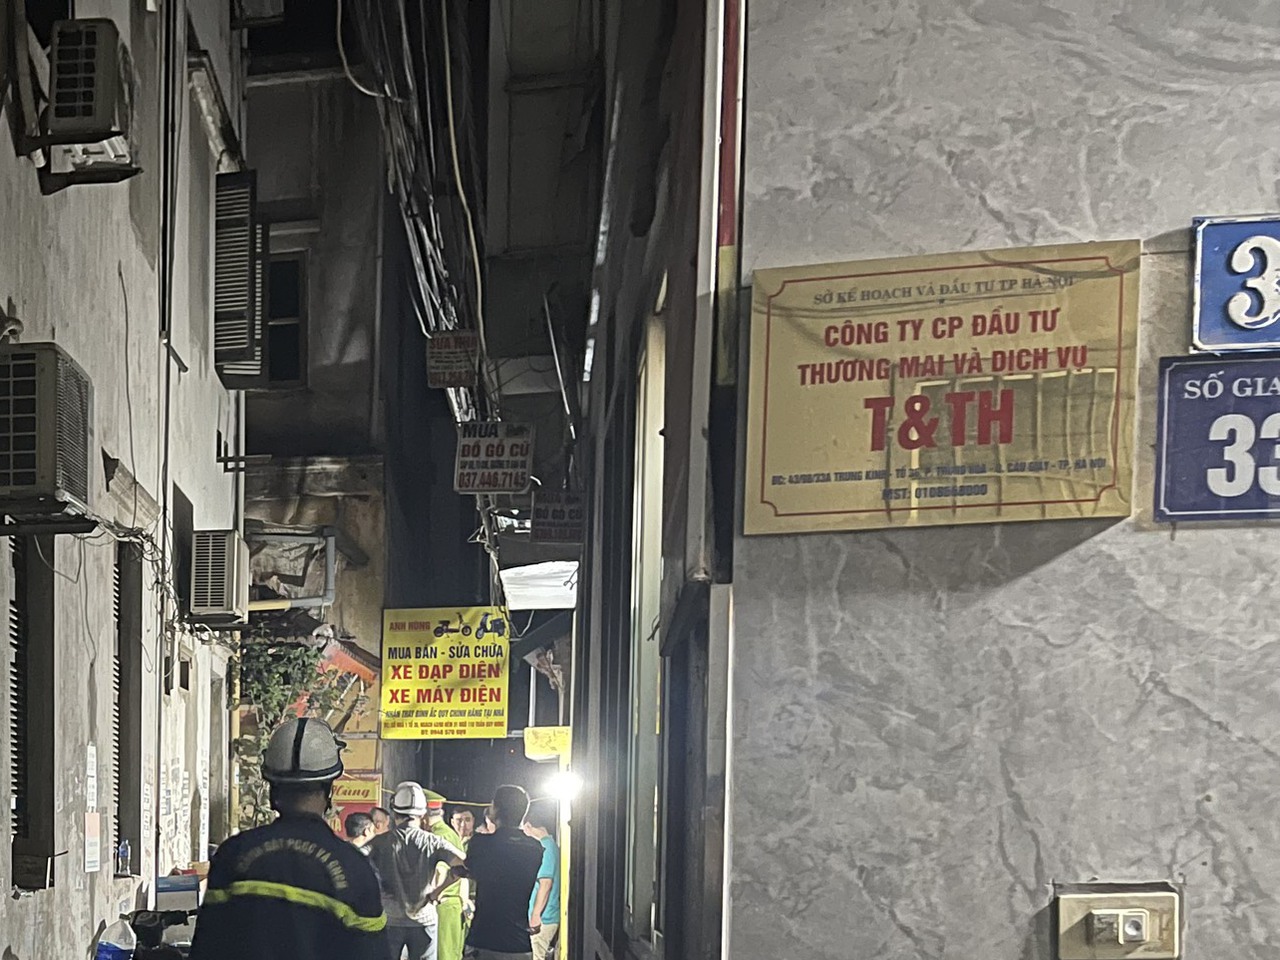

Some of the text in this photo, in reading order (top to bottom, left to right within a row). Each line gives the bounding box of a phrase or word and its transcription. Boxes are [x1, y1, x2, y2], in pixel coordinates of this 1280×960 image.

[999, 279, 1018, 291] TP
[824, 305, 1062, 347] CÔNG TY CP ĐẦU TƯ
[797, 358, 891, 386] THƯƠNG
[953, 347, 983, 375] VÀ
[991, 347, 1049, 377] DỊCH
[1057, 345, 1088, 373] VỤ
[1184, 371, 1225, 399] SỐ
[463, 423, 498, 438] MUA
[864, 389, 1014, 452] T&TH
[388, 647, 411, 659] MUA
[415, 644, 437, 659] BÁN
[391, 661, 501, 682] XE ĐẠP ĐIỆN
[389, 684, 501, 706] XE MÁY ĐIỆN
